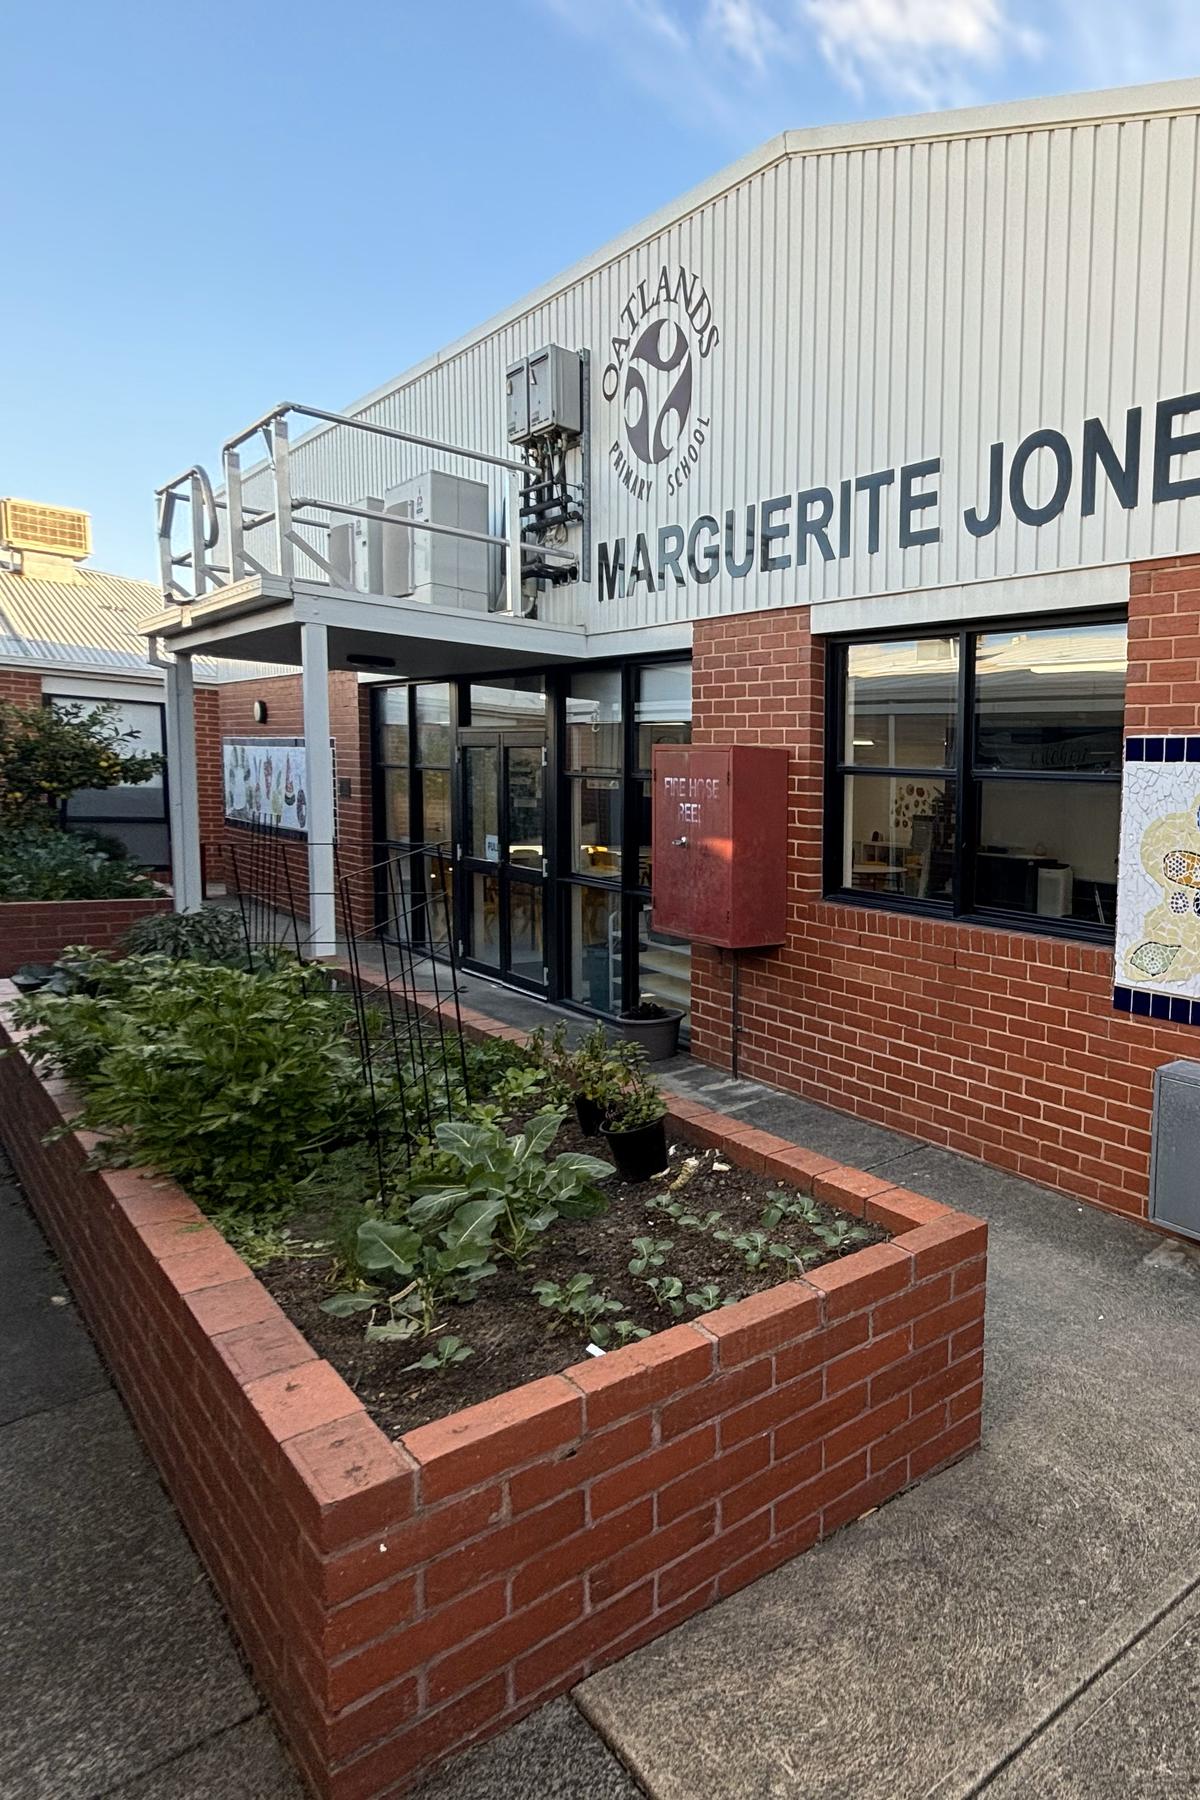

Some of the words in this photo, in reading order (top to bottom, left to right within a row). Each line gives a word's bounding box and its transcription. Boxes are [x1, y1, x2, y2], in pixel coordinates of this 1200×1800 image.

[602, 265, 720, 402] OATLANDS
[608, 440, 653, 502] PRIMARY
[667, 416, 710, 497] SCHOOL
[597, 456, 941, 600] MARGUERITE
